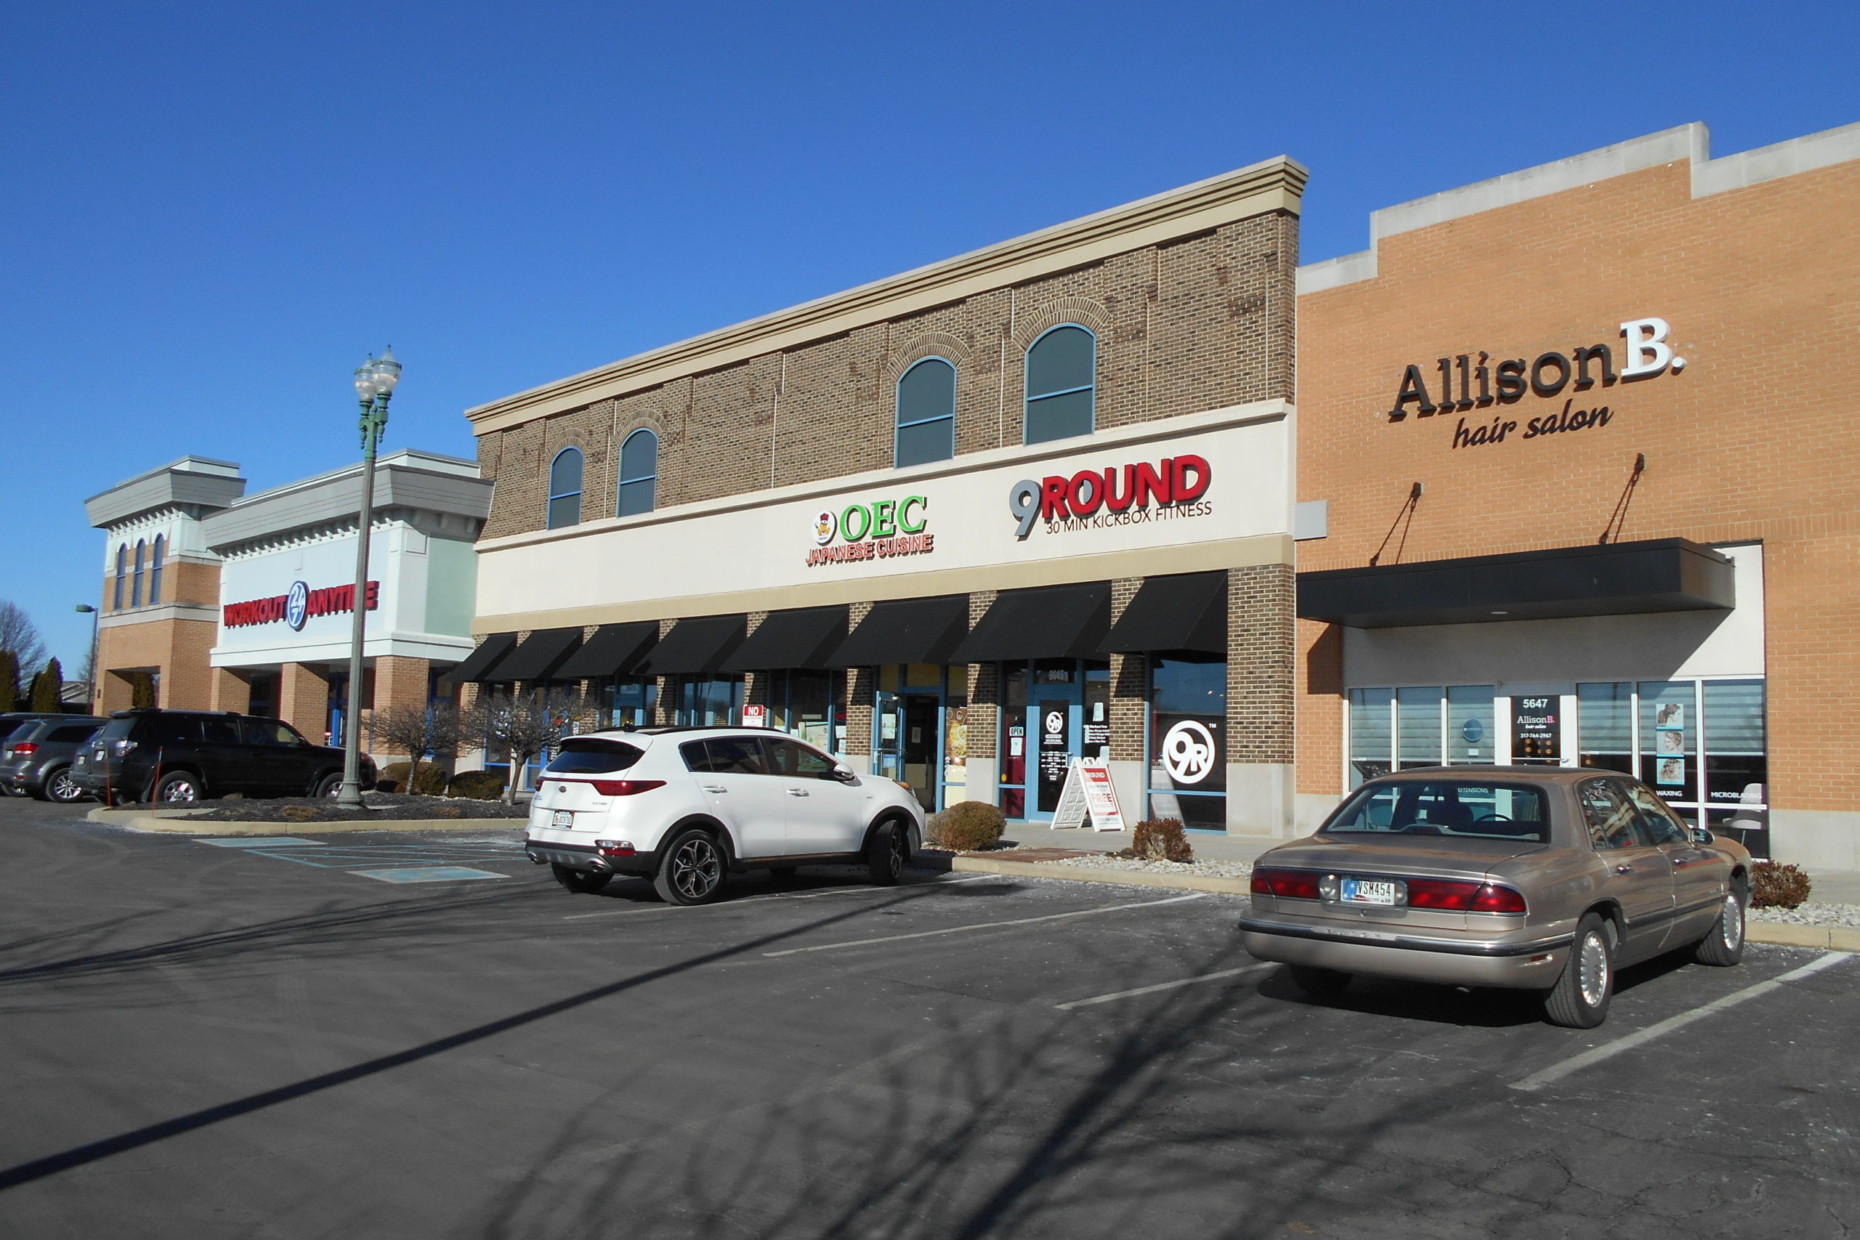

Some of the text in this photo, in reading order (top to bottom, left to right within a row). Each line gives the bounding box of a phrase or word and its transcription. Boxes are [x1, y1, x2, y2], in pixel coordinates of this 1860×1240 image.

[1452, 398, 1614, 449] hair salon
[839, 495, 927, 542] OEC
[1046, 501, 1212, 535] 30 MIN KICKBOX FITNESS
[805, 533, 934, 566] JAPANESE CUISINE
[224, 594, 287, 628] WORKOUT
[307, 581, 379, 617] ANYTIE
[747, 706, 759, 716] NO
[1522, 698, 1548, 709] 5647
[1010, 727, 1023, 735] OPEN
[1655, 789, 1683, 797] WAXING
